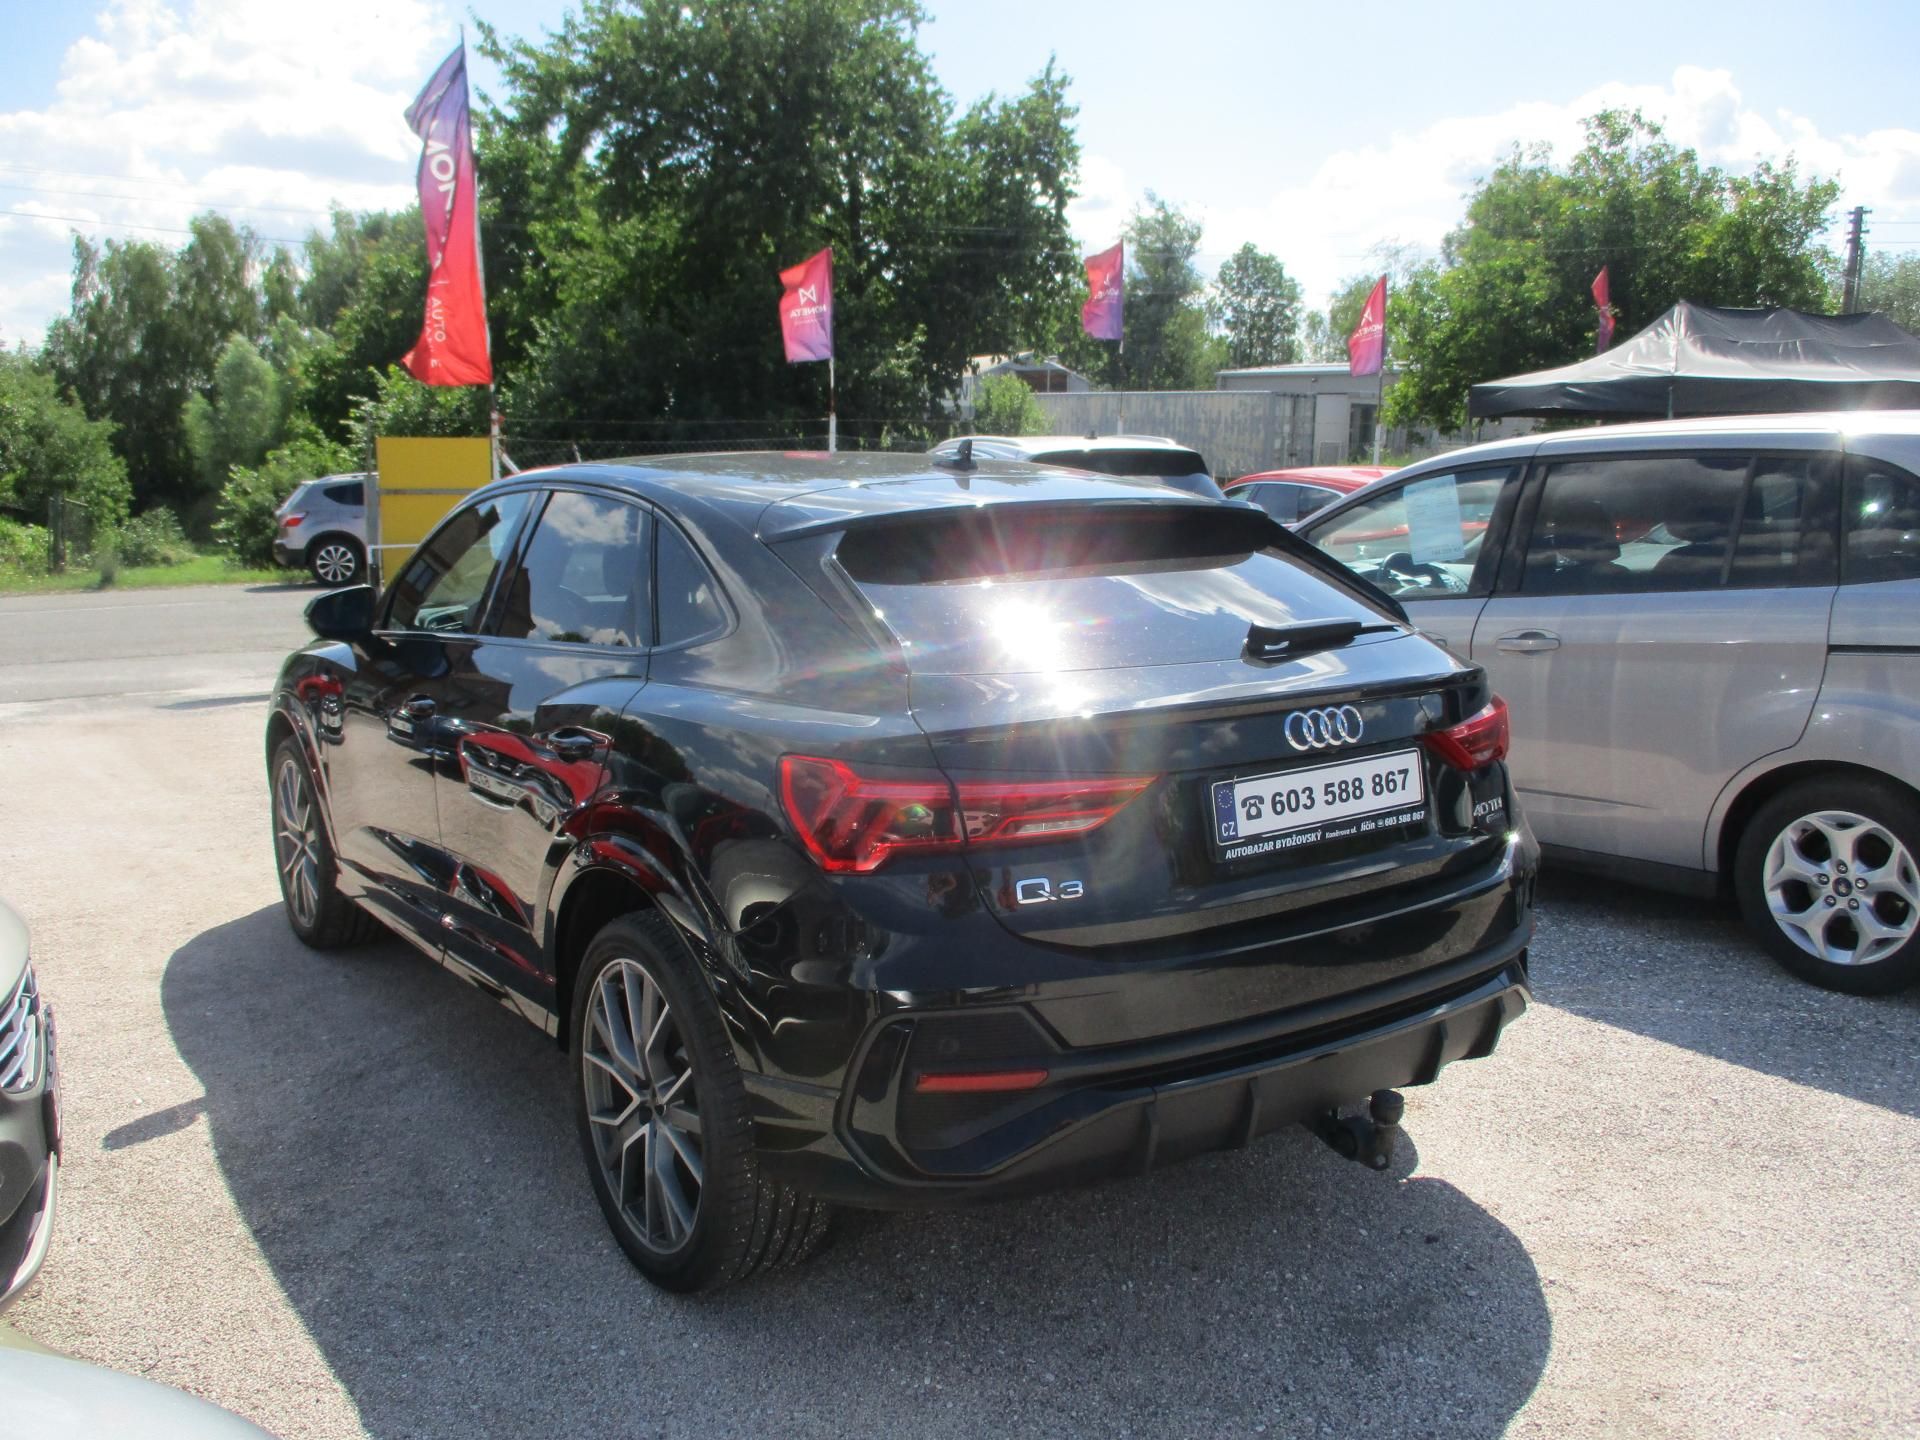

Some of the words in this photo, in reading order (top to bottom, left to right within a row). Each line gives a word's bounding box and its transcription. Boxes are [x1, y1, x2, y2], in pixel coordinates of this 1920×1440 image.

[431, 296, 447, 343] AUTO
[1271, 786, 1316, 816] 603
[1323, 777, 1364, 806] 588
[1371, 768, 1410, 796] 867
[1221, 821, 1236, 837] CZ
[1225, 841, 1274, 859] AUTOBAZAR
[1275, 829, 1322, 849] BYDŽOVSKÝ
[1360, 820, 1376, 832] Jičín
[1384, 816, 1397, 827] 603
[1398, 813, 1411, 824] 588
[1412, 810, 1425, 821] 867
[1016, 878, 1084, 905] Q3
